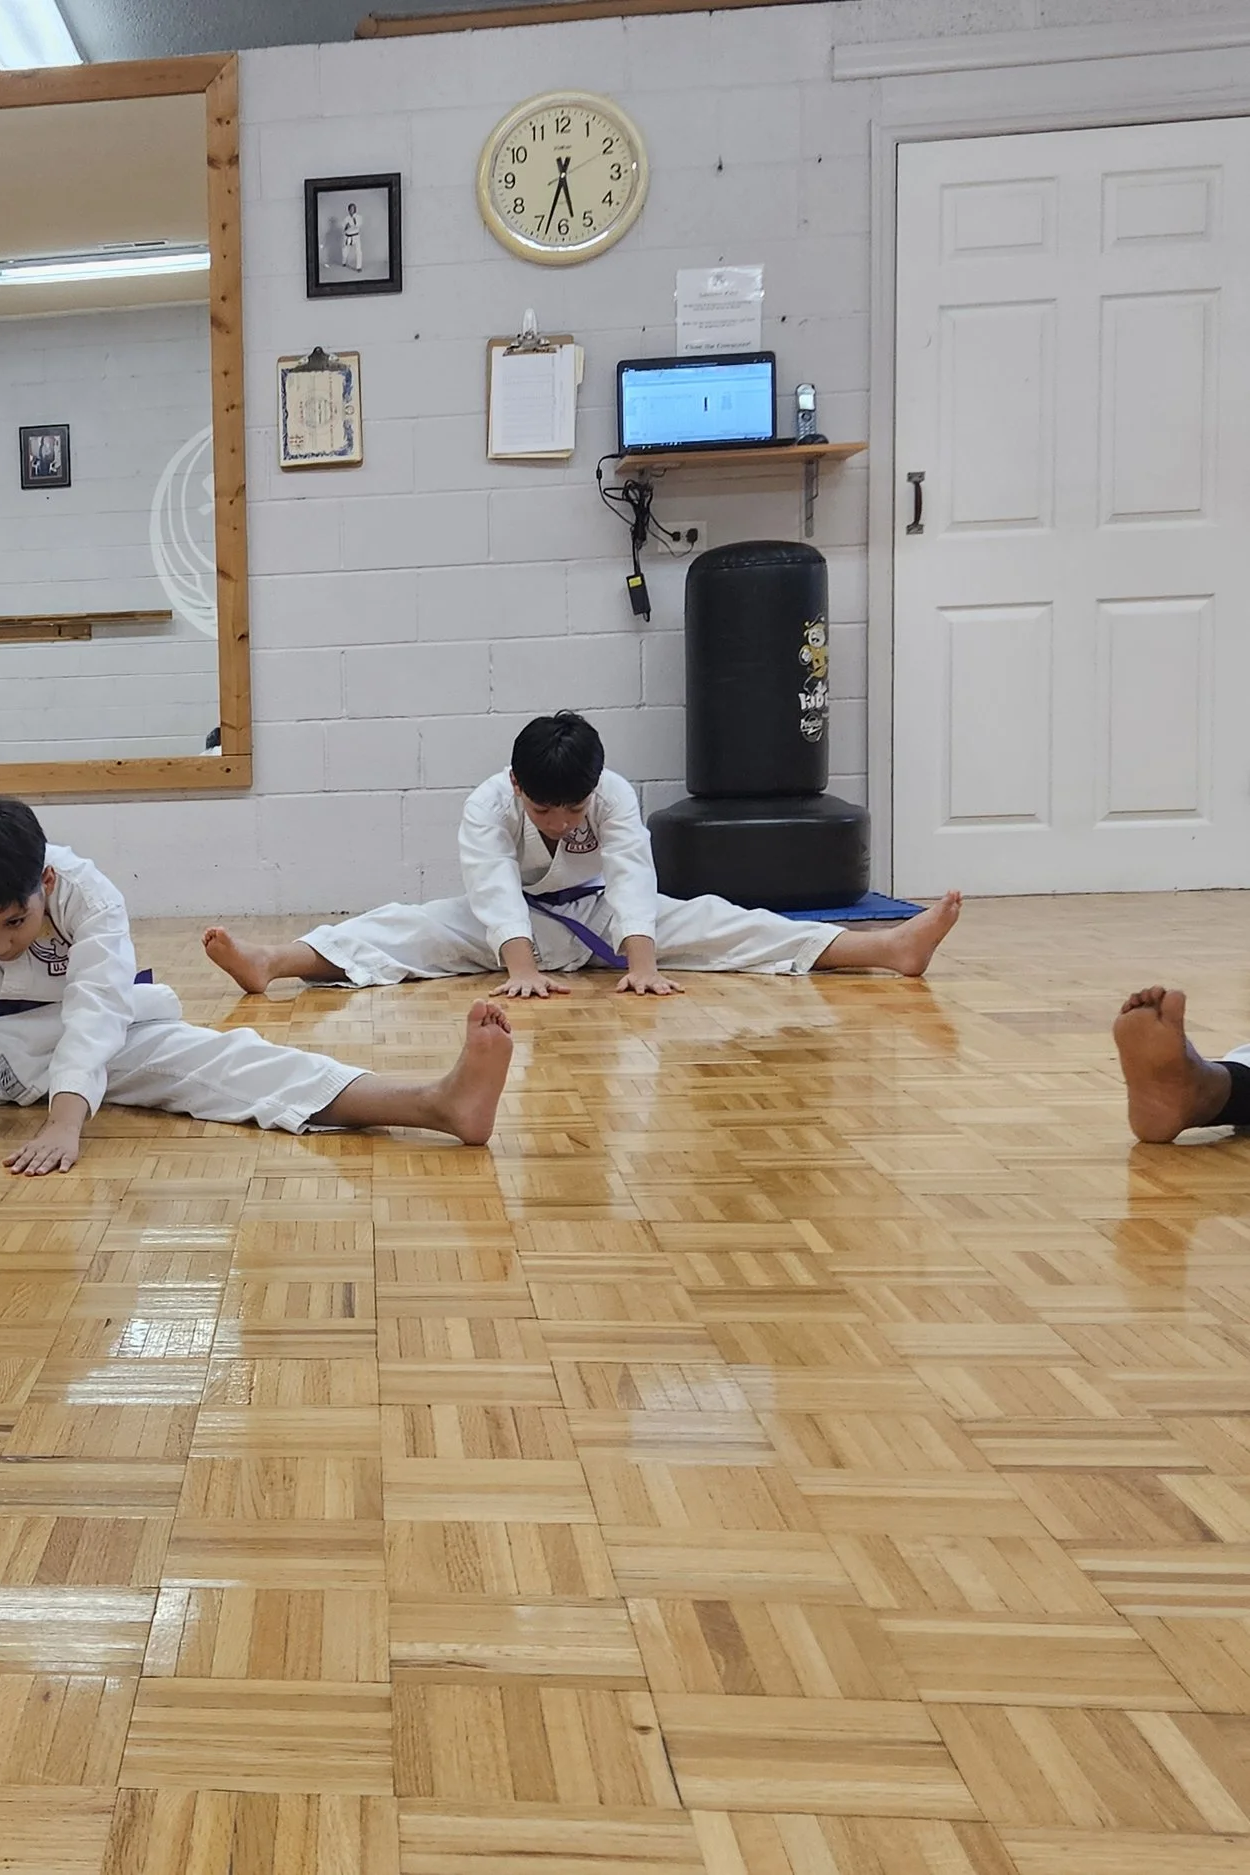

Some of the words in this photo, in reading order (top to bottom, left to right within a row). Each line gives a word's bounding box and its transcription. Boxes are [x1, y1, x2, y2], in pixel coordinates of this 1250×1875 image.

[532, 125, 545, 142] 11
[555, 116, 571, 134] 12
[585, 121, 590, 138] 1
[602, 137, 614, 155] 2
[511, 146, 528, 164] 10
[504, 172, 516, 189] 9
[610, 163, 622, 181] 3
[513, 197, 525, 214] 8
[601, 190, 613, 207] 4
[534, 214, 545, 232] 7
[557, 218, 570, 235] 6
[582, 210, 594, 227] 5
